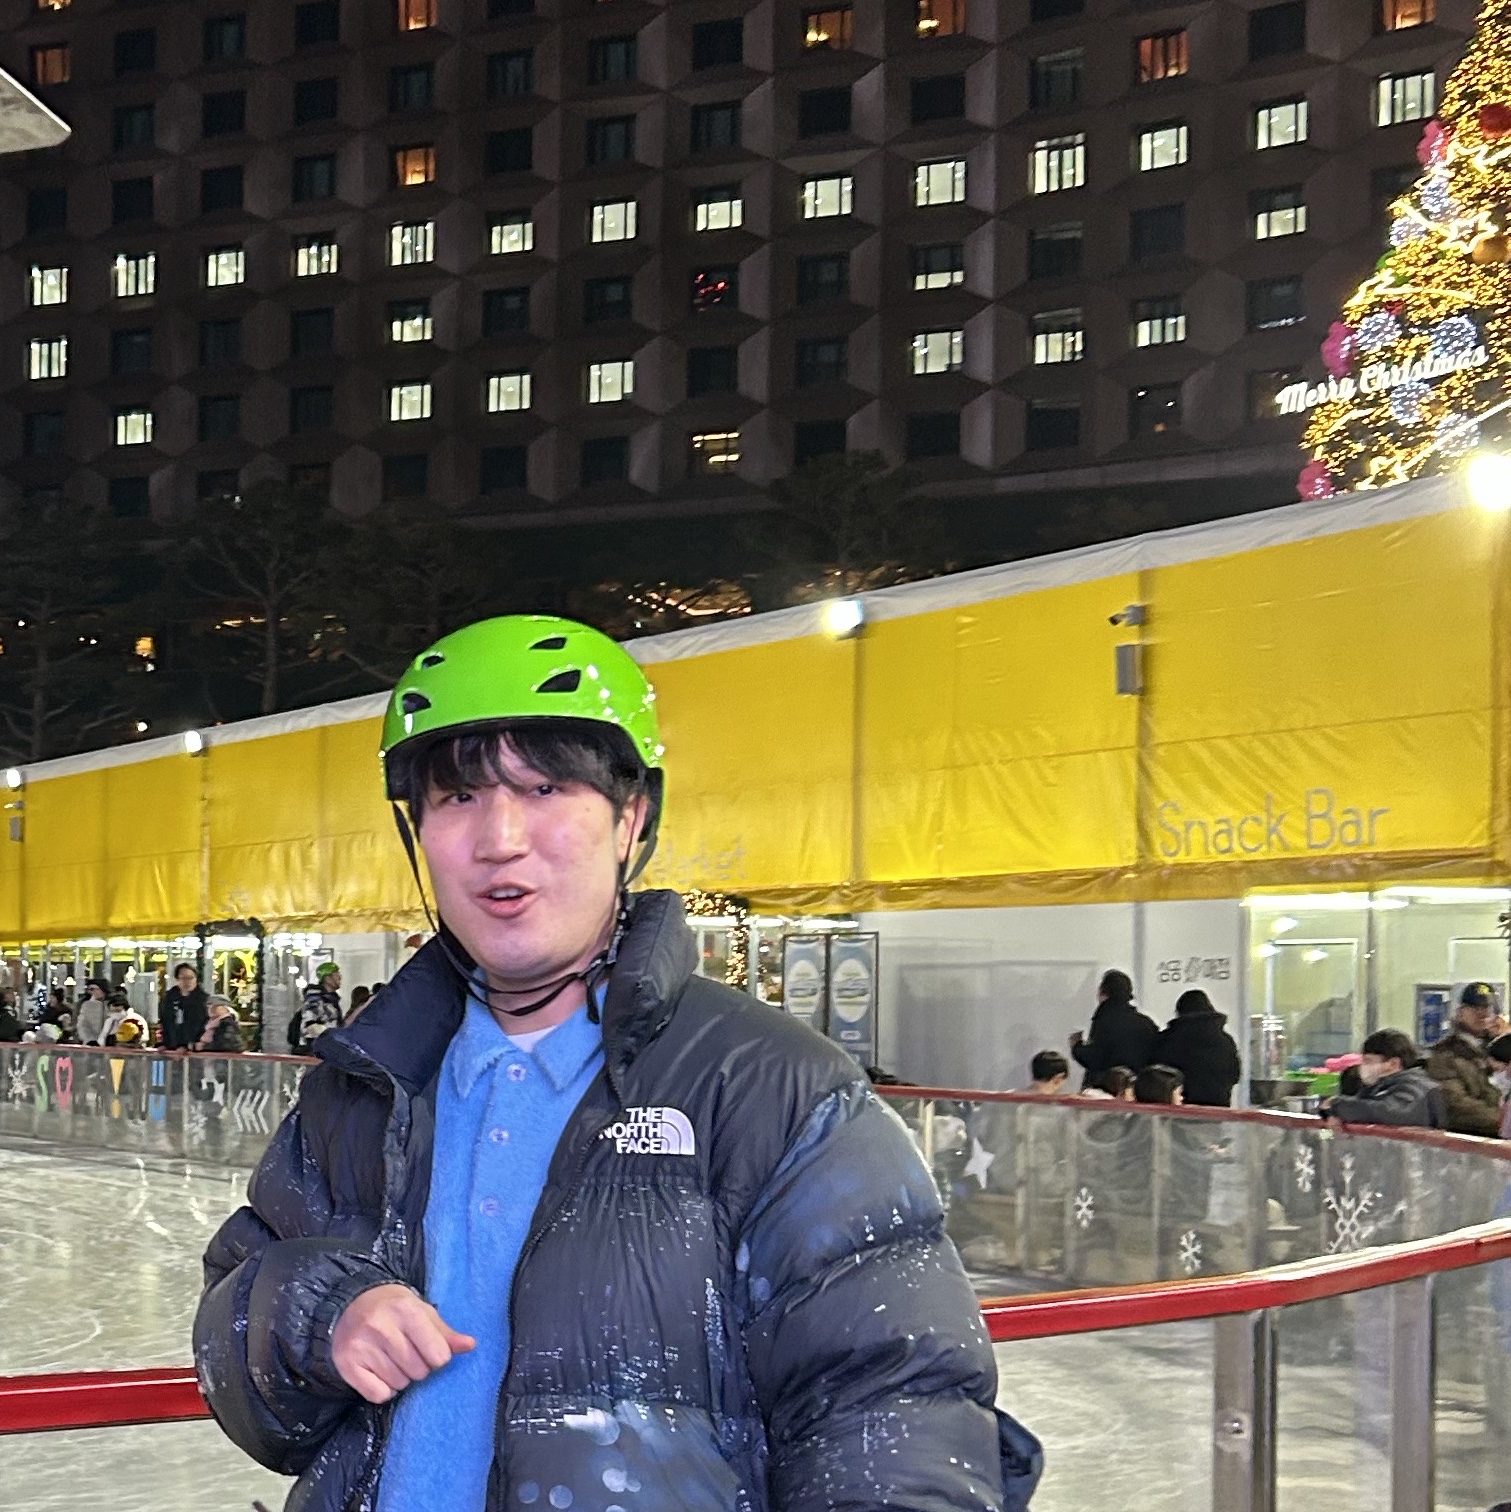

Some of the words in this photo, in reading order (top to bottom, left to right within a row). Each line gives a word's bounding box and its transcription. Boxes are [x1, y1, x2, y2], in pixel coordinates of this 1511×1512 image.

[1274, 374, 1357, 415] Merry
[1359, 345, 1490, 393] Christmas
[1157, 791, 1291, 858] Snack
[1304, 787, 1391, 850] Bar
[625, 1107, 663, 1123] THE
[598, 1122, 663, 1139] NORTH
[616, 1138, 664, 1154] FACE
